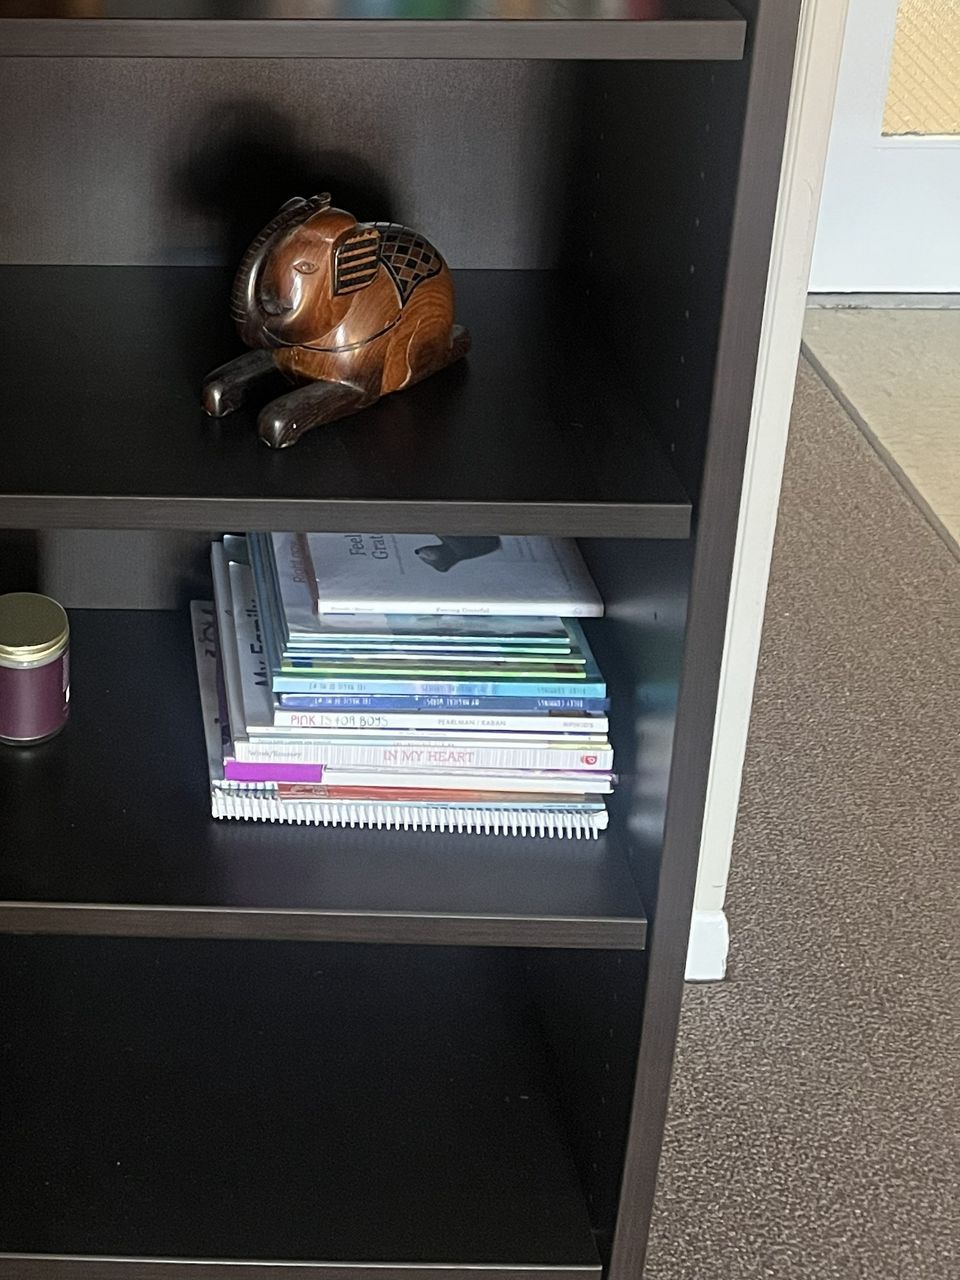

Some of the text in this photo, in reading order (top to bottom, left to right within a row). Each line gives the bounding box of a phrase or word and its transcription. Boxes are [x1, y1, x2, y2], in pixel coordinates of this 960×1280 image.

[290, 715, 389, 727] PINK BOYS
[382, 750, 475, 764] IN MY HEART
